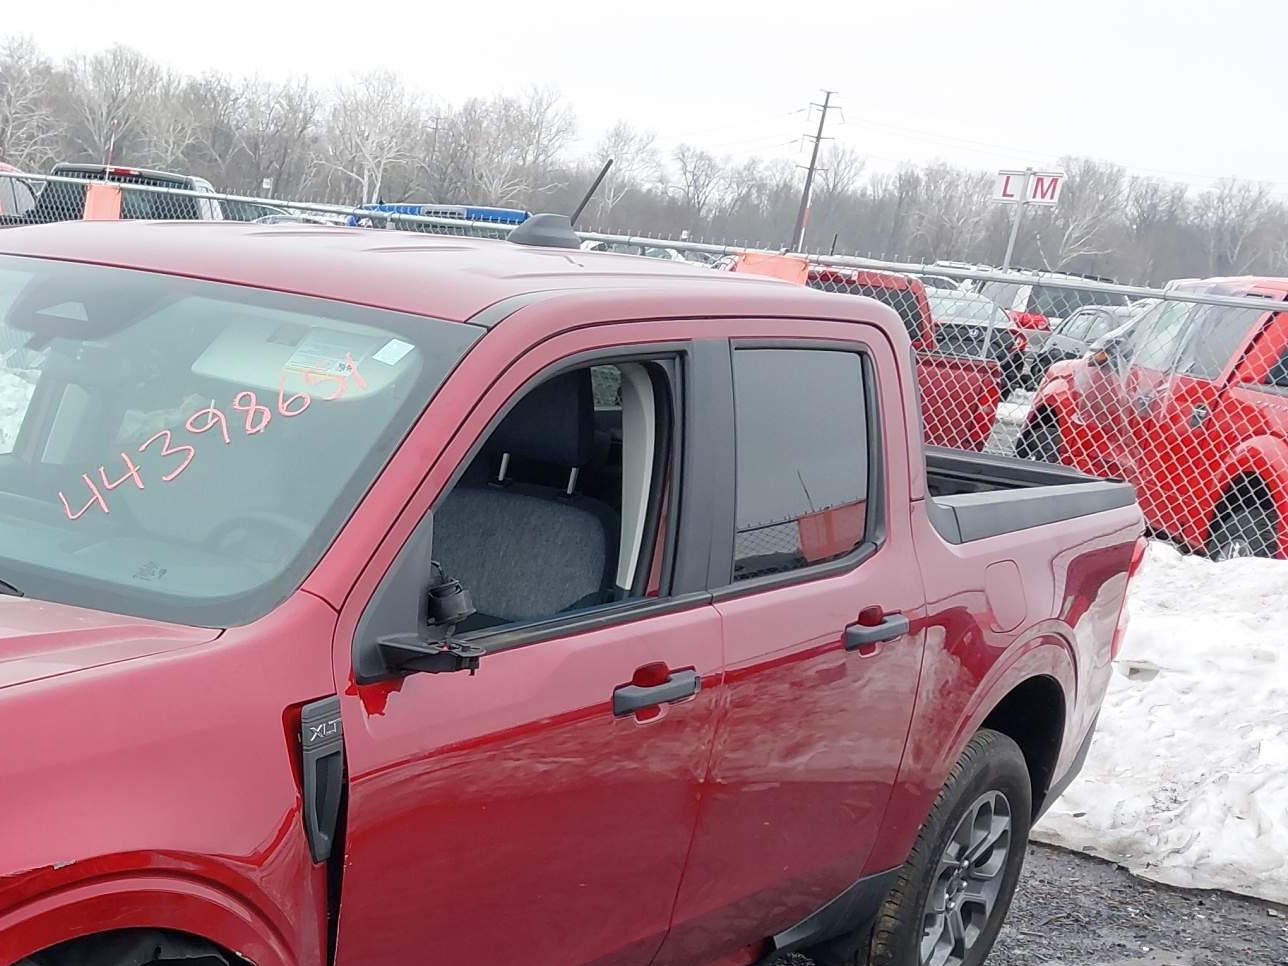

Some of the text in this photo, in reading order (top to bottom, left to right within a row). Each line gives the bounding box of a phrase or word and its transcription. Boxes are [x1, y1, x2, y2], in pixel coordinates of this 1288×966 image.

[1001, 175, 1015, 198] L
[1031, 177, 1060, 200] M
[57, 351, 369, 521] 44398651
[309, 717, 343, 742] XLT
